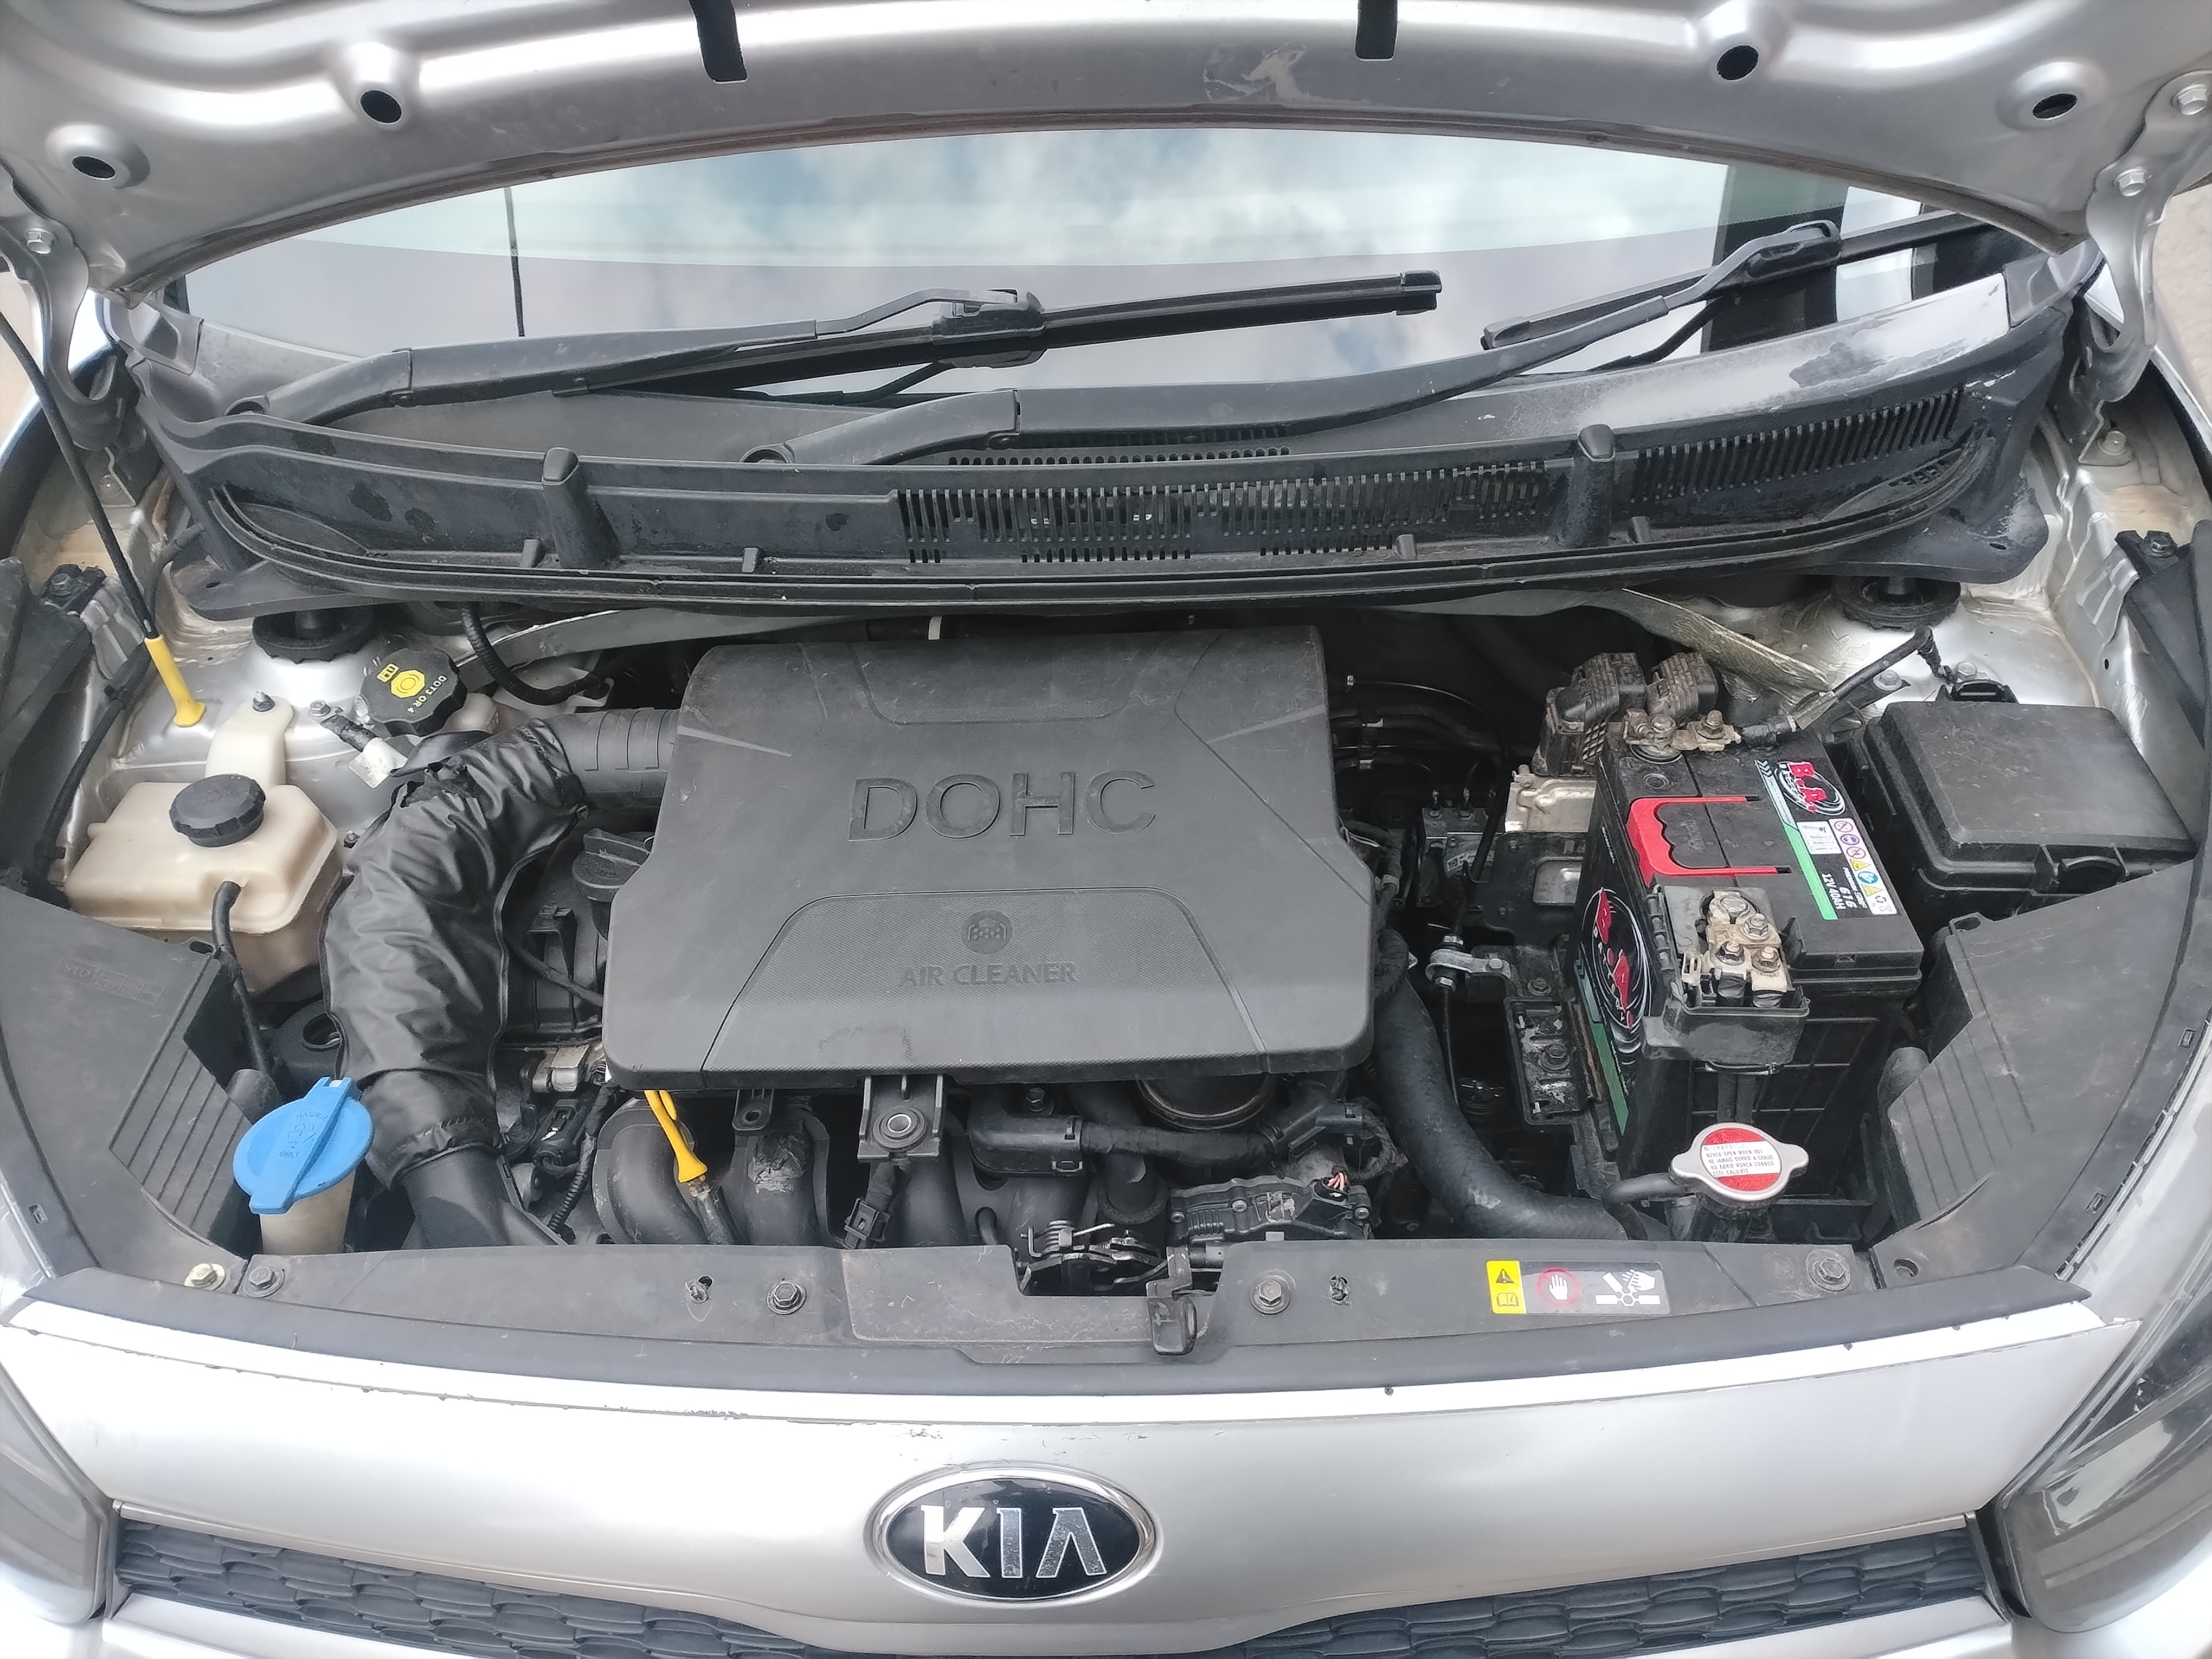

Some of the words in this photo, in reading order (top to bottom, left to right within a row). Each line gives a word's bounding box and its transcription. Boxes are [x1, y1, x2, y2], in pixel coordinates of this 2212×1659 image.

[425, 674, 447, 696] DOT3
[407, 705, 416, 715] 4
[412, 693, 428, 708] OR
[847, 769, 1157, 842] DOHC
[1821, 873, 1837, 891] 12V
[1828, 888, 1847, 910] 40AH
[1838, 886, 1856, 909] 616
[65, 963, 92, 978] STD
[897, 964, 946, 988] AIR
[951, 962, 1078, 986] CLEANER
[278, 1149, 300, 1159] ONLY
[920, 1503, 1108, 1579] KIA
